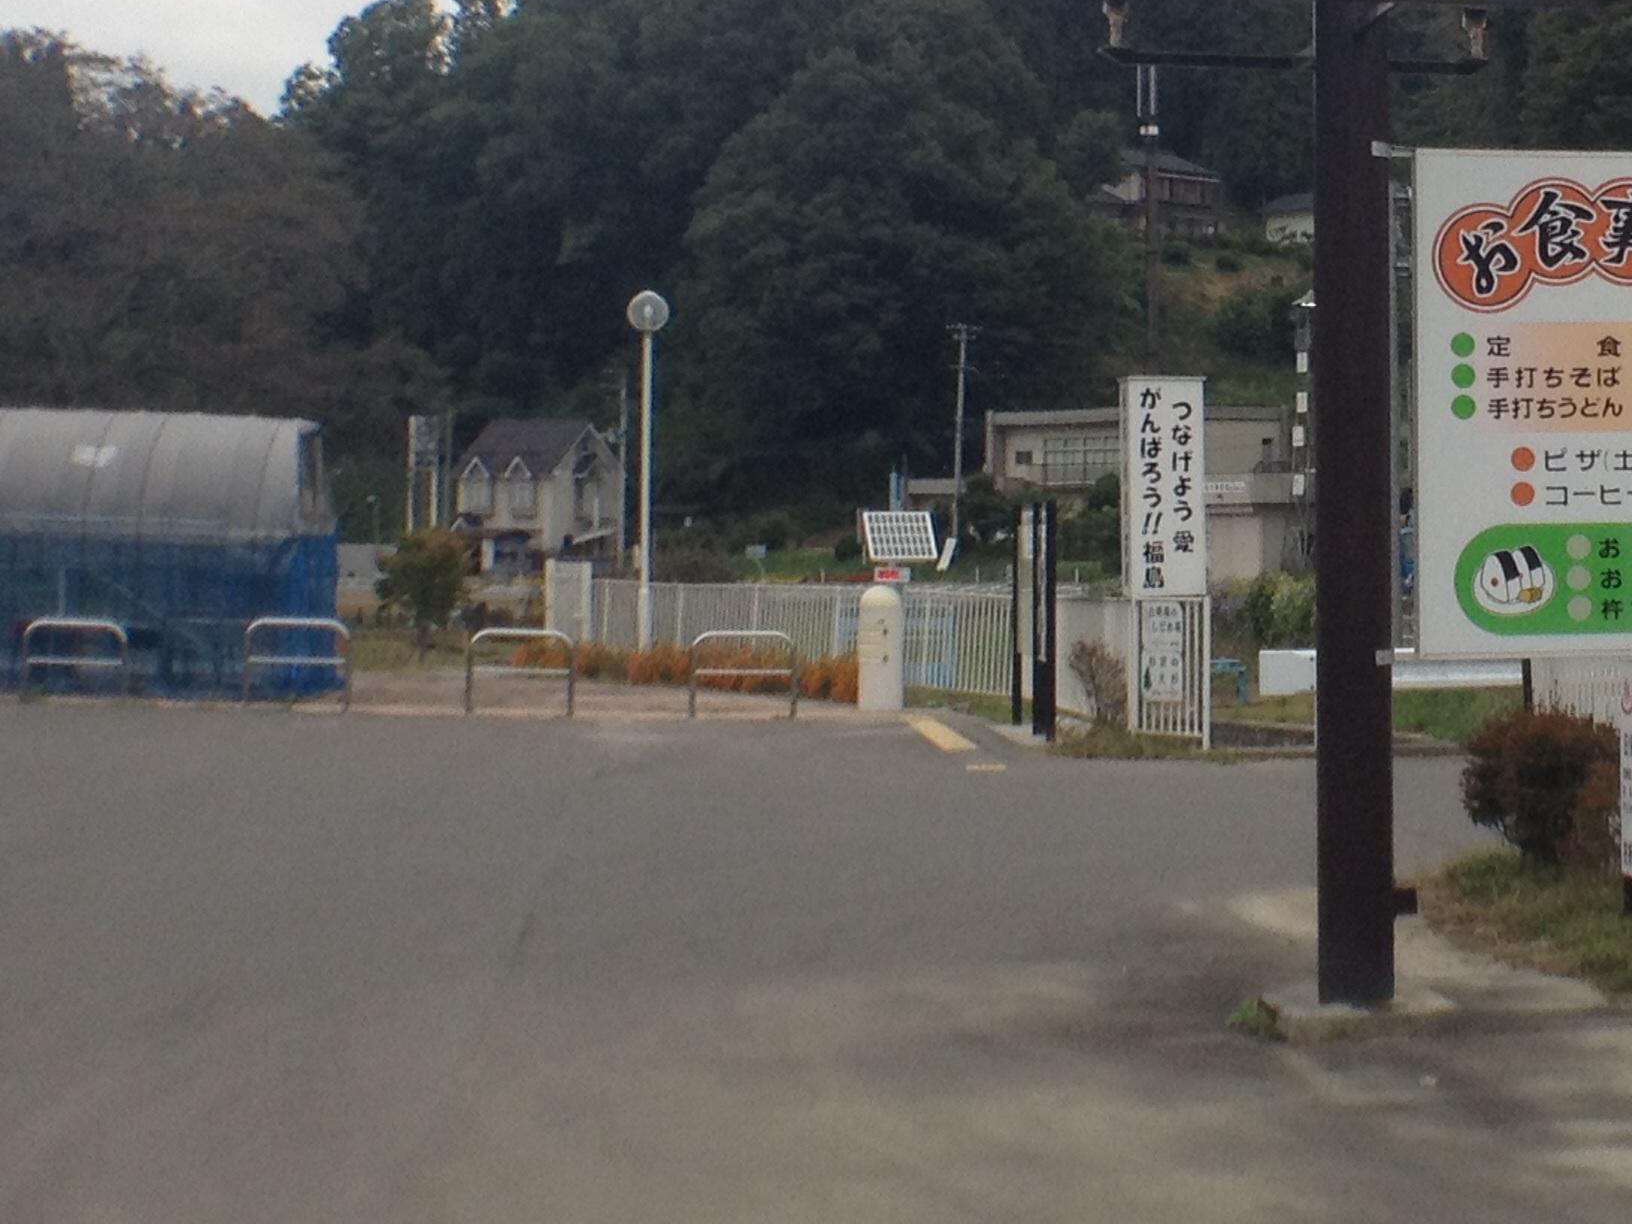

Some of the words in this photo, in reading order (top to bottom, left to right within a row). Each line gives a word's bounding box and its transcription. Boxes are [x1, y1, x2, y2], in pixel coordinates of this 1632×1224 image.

[1486, 335, 1622, 358] 定食
[1486, 366, 1621, 389] 手打ちそば
[1486, 397, 1623, 420] 手打ちうどん
